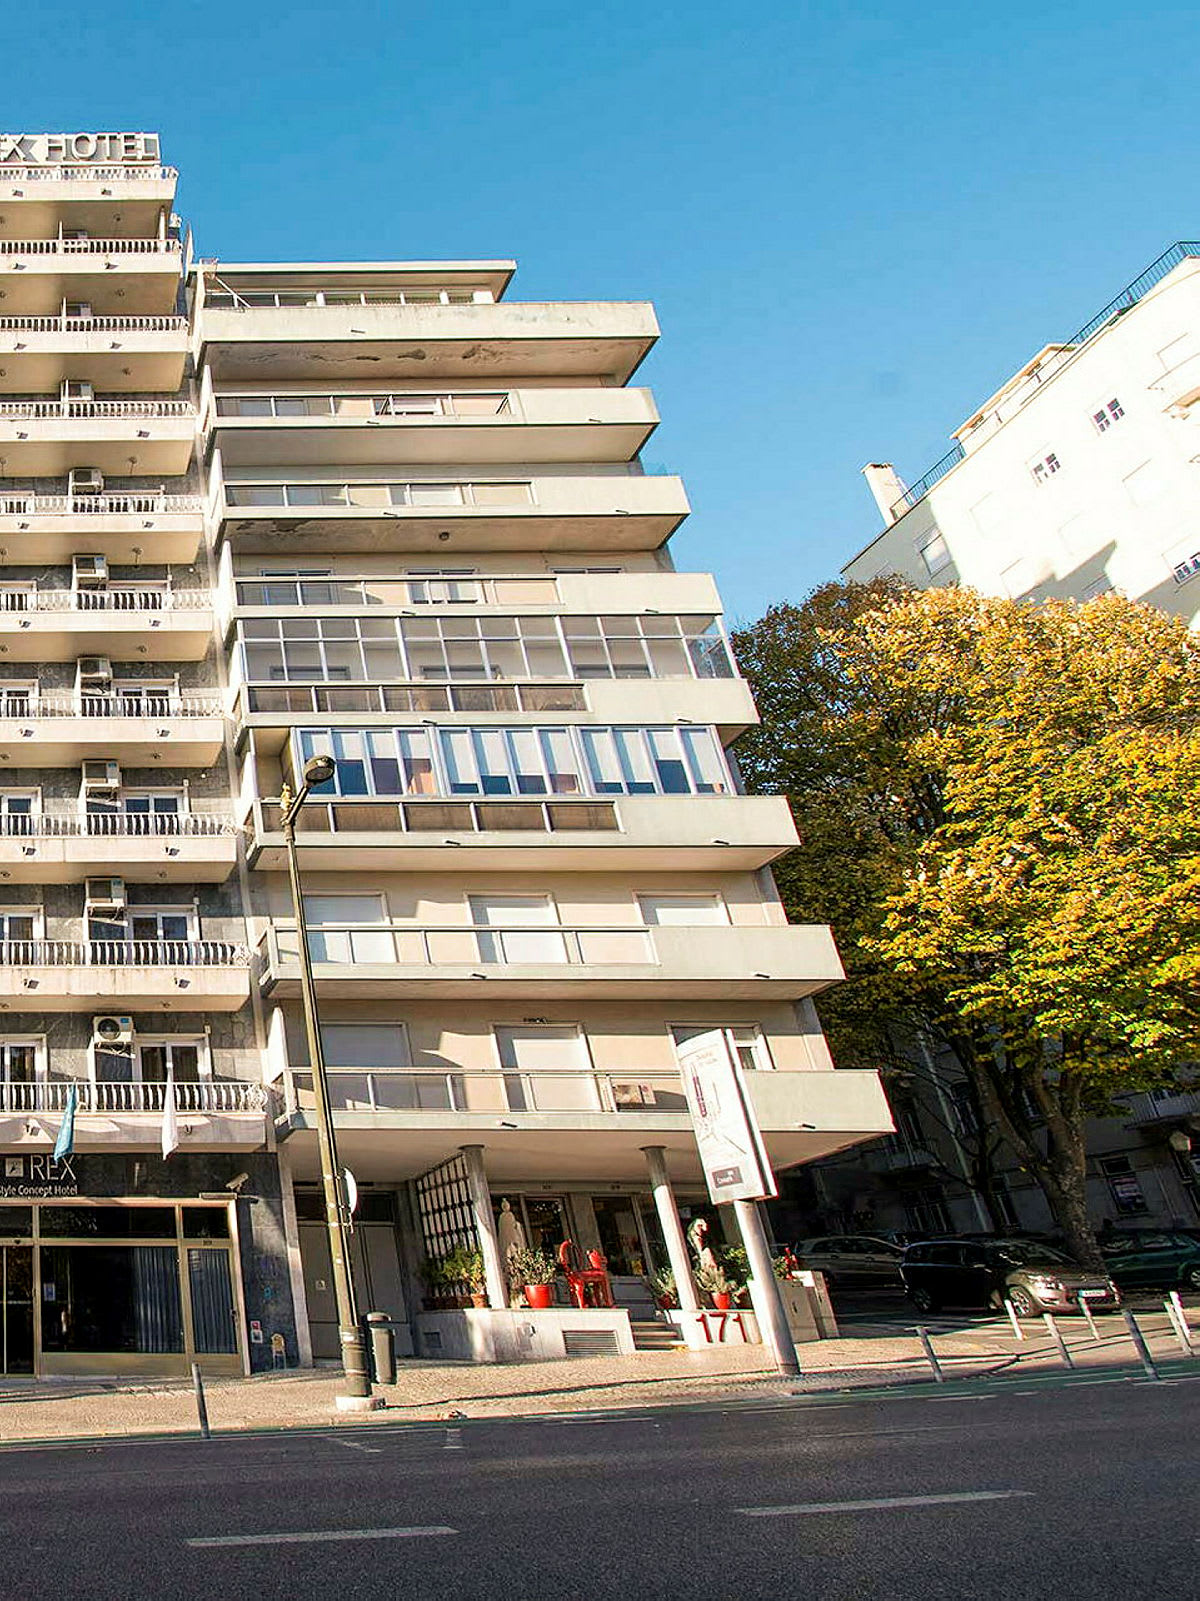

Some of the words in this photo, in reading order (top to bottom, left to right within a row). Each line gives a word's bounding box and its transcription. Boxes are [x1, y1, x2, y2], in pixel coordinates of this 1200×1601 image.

[45, 133, 158, 161] HOTEL
[30, 1154, 76, 1181] REX
[18, 1184, 52, 1198] Concept
[54, 1184, 78, 1196] Hotel
[695, 1312, 749, 1343] 171
